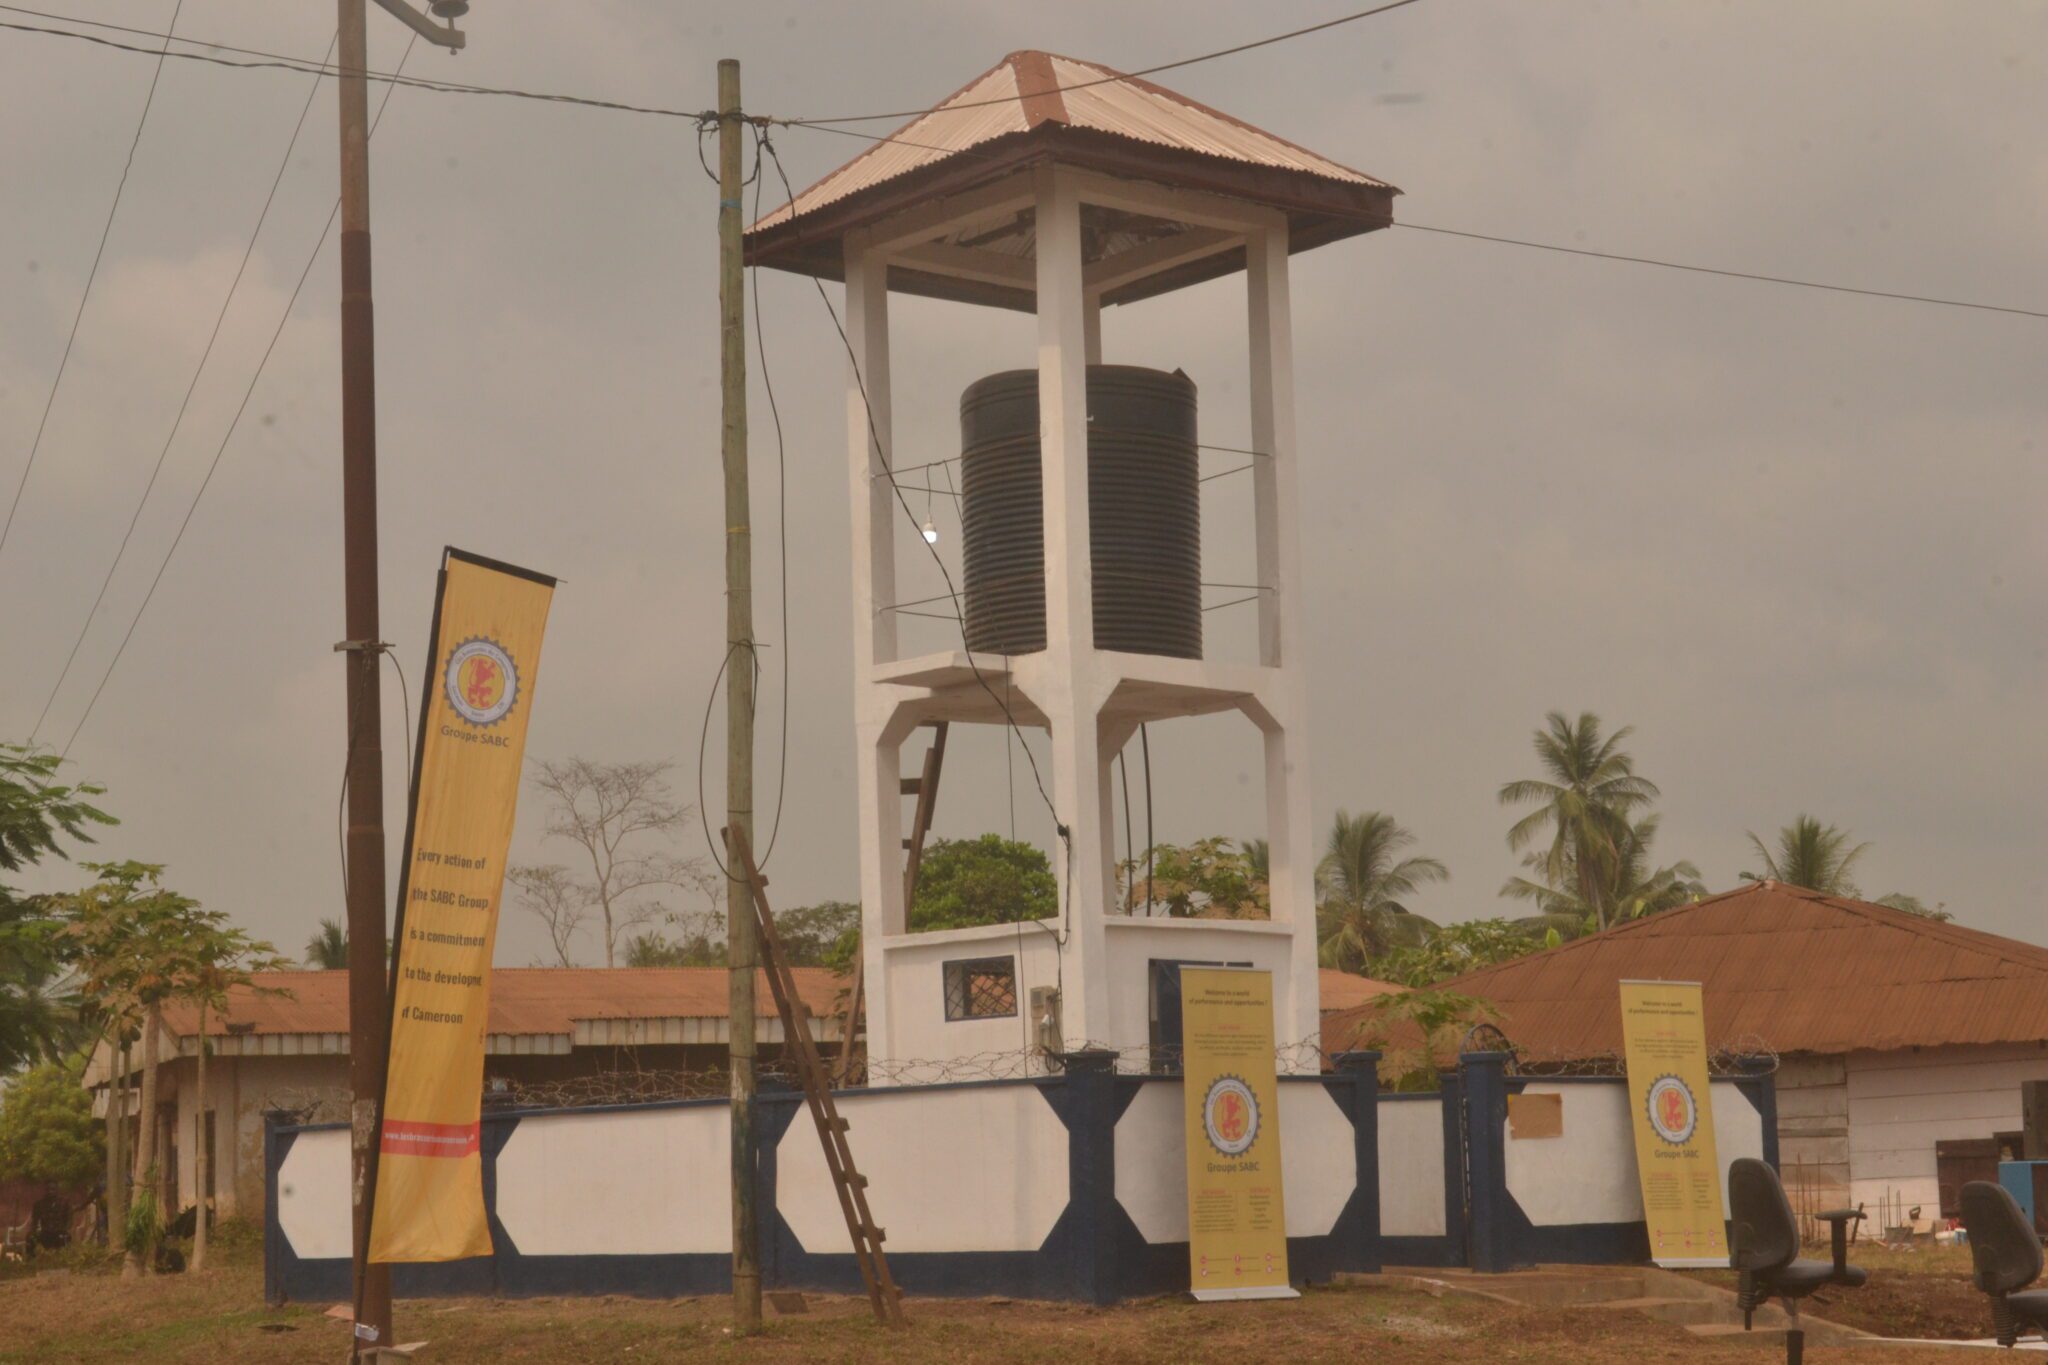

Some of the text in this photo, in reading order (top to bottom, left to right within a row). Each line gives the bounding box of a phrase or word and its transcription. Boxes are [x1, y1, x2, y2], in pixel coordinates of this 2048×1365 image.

[440, 724, 510, 748] Groupe SABC
[416, 848, 487, 870] Every action of
[412, 887, 489, 911] the SABC Group
[410, 927, 485, 947] is a commitmen
[405, 967, 415, 980] to
[417, 967, 432, 982] the
[412, 1007, 463, 1024] Cameroon
[1654, 1150, 1700, 1160] Groupe SABC
[1207, 1161, 1260, 1174] Groupe SABC
